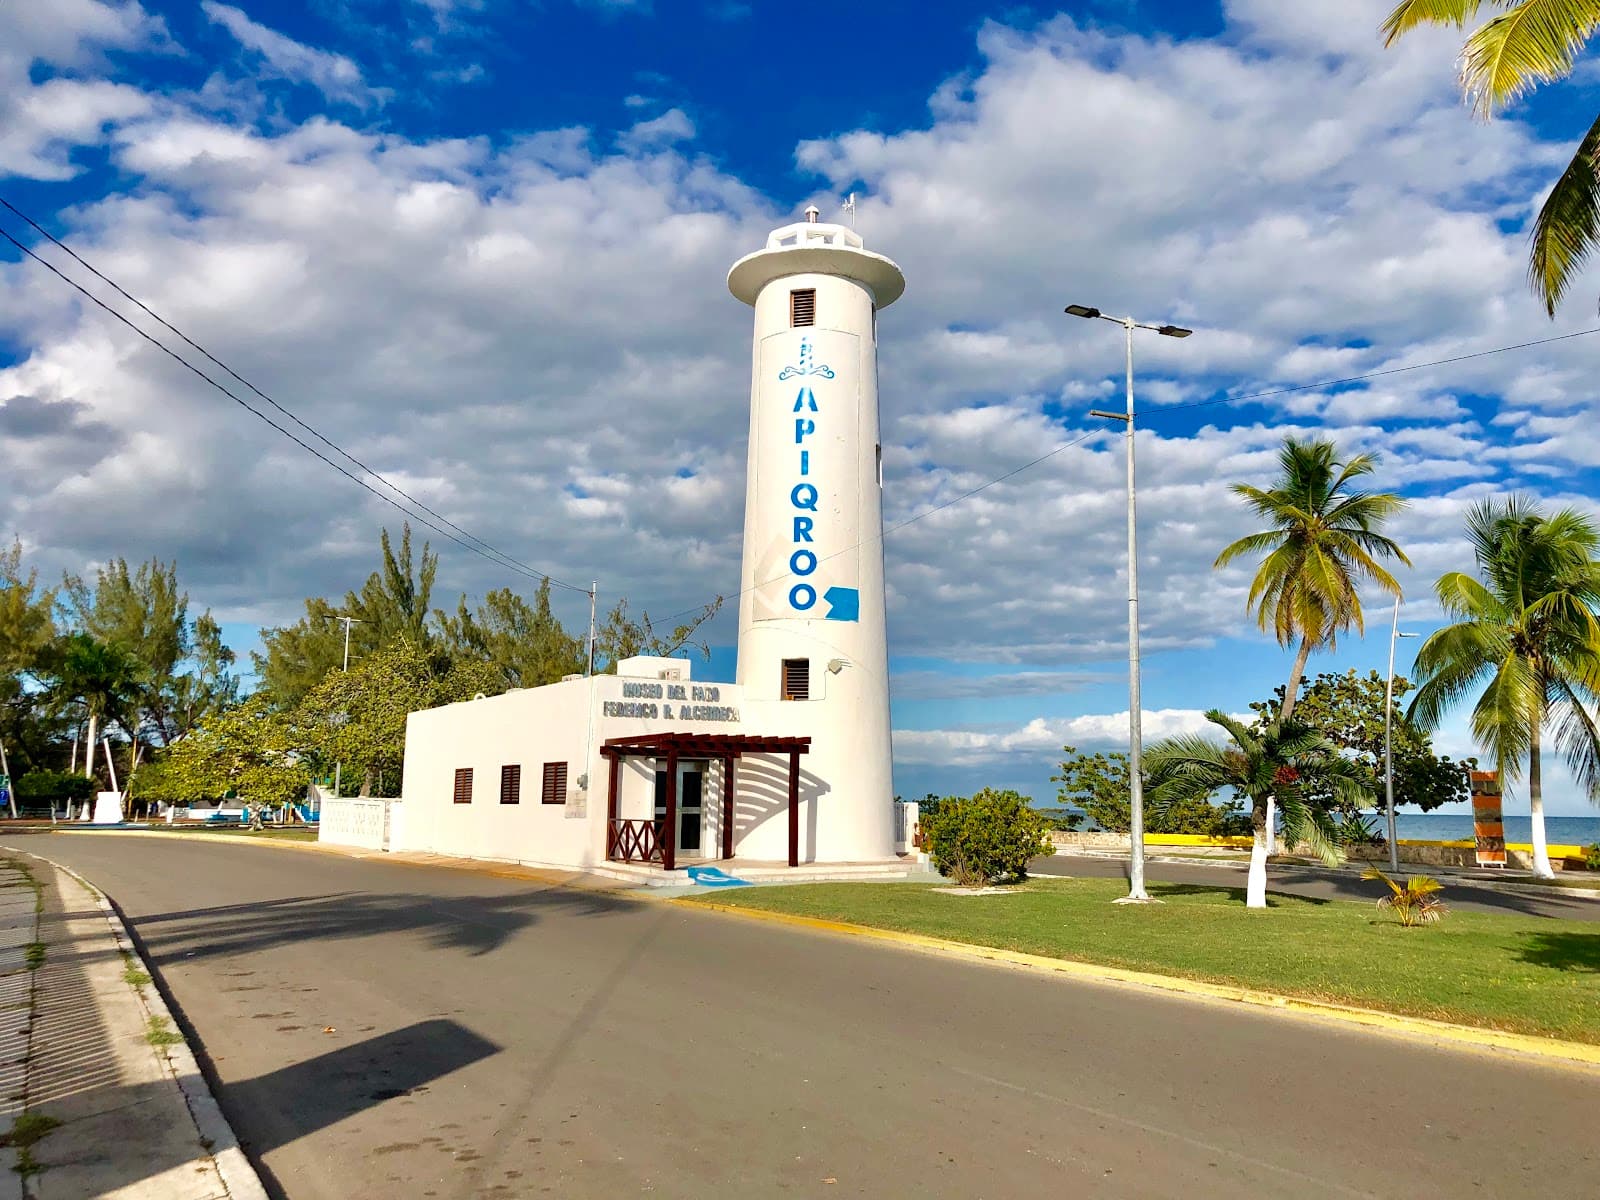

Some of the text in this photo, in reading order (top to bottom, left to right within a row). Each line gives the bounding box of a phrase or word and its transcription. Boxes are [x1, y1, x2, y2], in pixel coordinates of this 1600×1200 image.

[789, 387, 819, 610] APIQROO
[623, 682, 720, 702] MUSEO DEL FARO
[603, 701, 658, 719] FEDERICO
